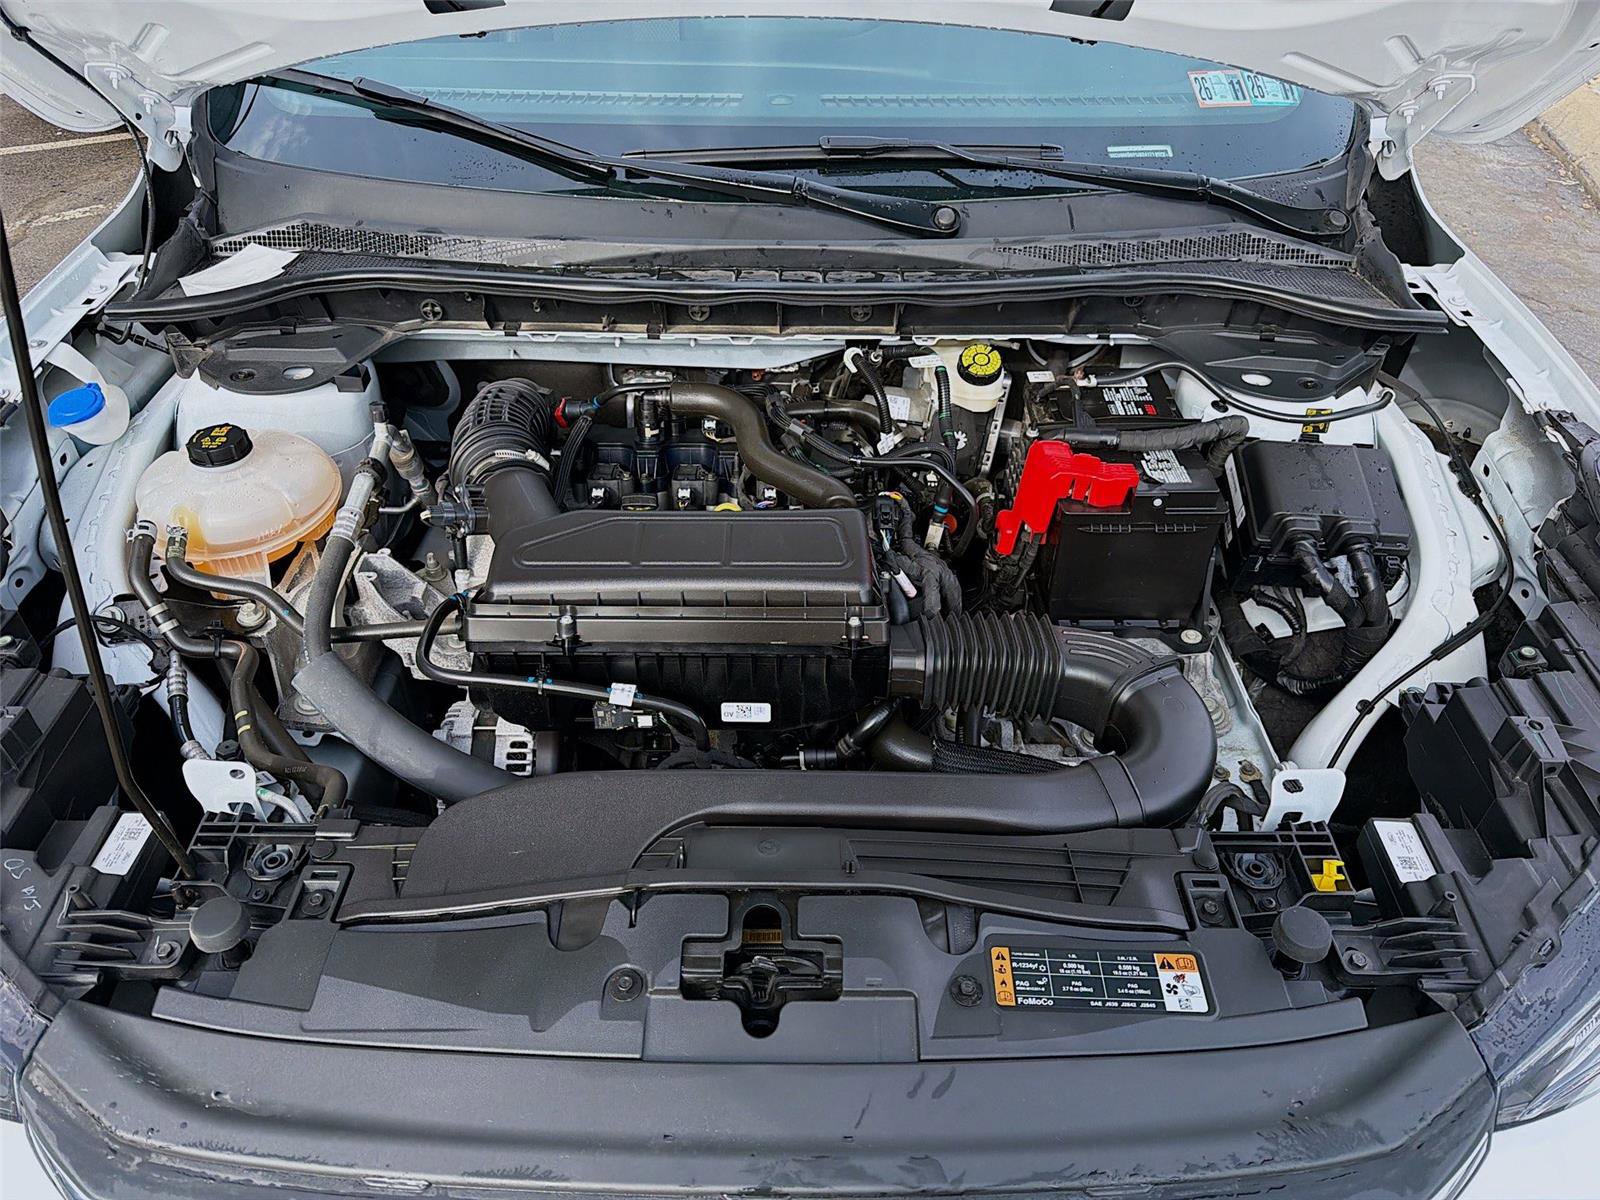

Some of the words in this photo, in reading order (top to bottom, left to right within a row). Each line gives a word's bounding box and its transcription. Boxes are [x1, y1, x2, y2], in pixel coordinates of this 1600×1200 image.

[1194, 77, 1213, 100] 26
[1228, 79, 1247, 101] 11
[1247, 75, 1265, 99] 26
[1012, 961, 1038, 970] R-1234yf
[1017, 997, 1054, 1006] FoMoCo
